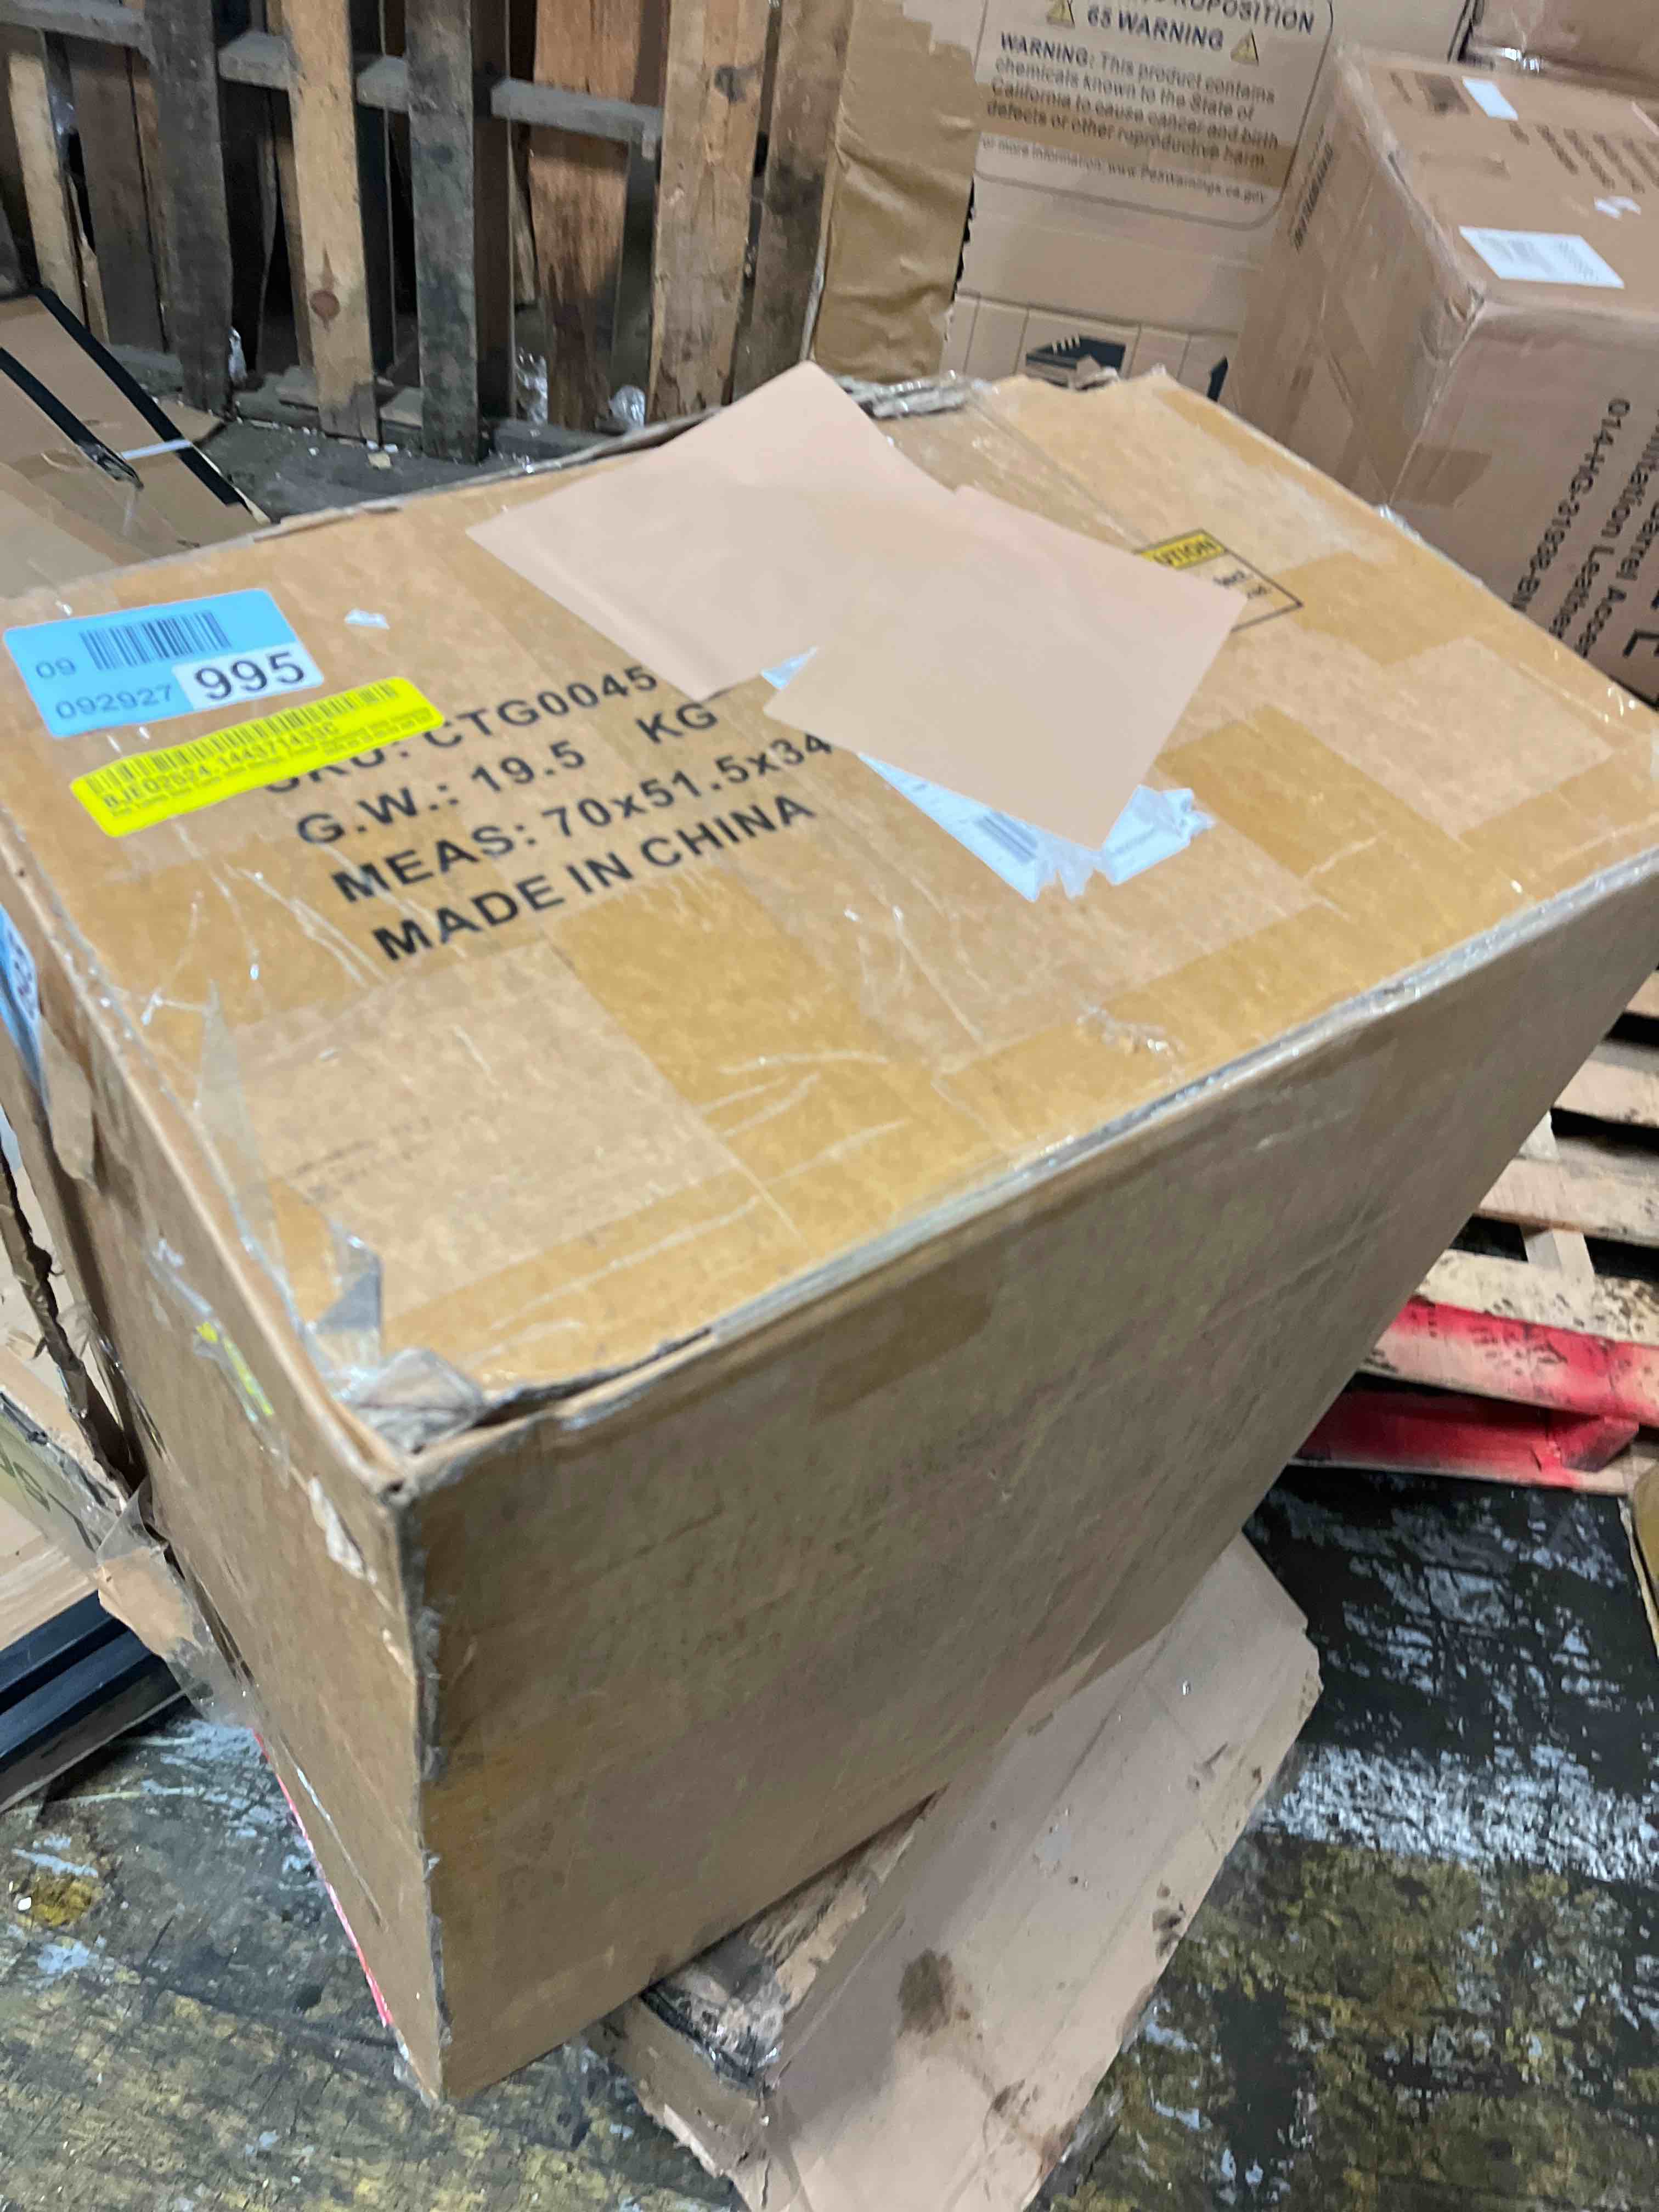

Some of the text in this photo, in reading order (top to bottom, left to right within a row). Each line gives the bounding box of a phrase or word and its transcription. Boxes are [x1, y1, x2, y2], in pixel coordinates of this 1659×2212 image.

[1087, 4, 1223, 51] 65 WARNING
[1156, 0, 1314, 35] OPOSITION
[995, 56, 1255, 121] chemicals known to the State of
[1000, 31, 1276, 105] WARNING: This product contains
[988, 99, 1047, 127] defects
[1051, 113, 1068, 131] or
[1071, 116, 1114, 140] other
[1118, 127, 1220, 160] reproductive
[991, 76, 1278, 150] California to cause cancer and birth
[1601, 409, 1659, 538] itation
[35, 656, 77, 680] 09
[54, 683, 172, 720] 092927
[194, 650, 305, 701] 995
[422, 665, 658, 748] CTG0045
[296, 783, 460, 845] G.W.:
[471, 740, 586, 792] 19.5
[635, 702, 718, 745] KG
[330, 819, 537, 903] MEAS:
[541, 733, 833, 838] 70x51.5x34
[372, 792, 817, 962] MADE IN CHINA
